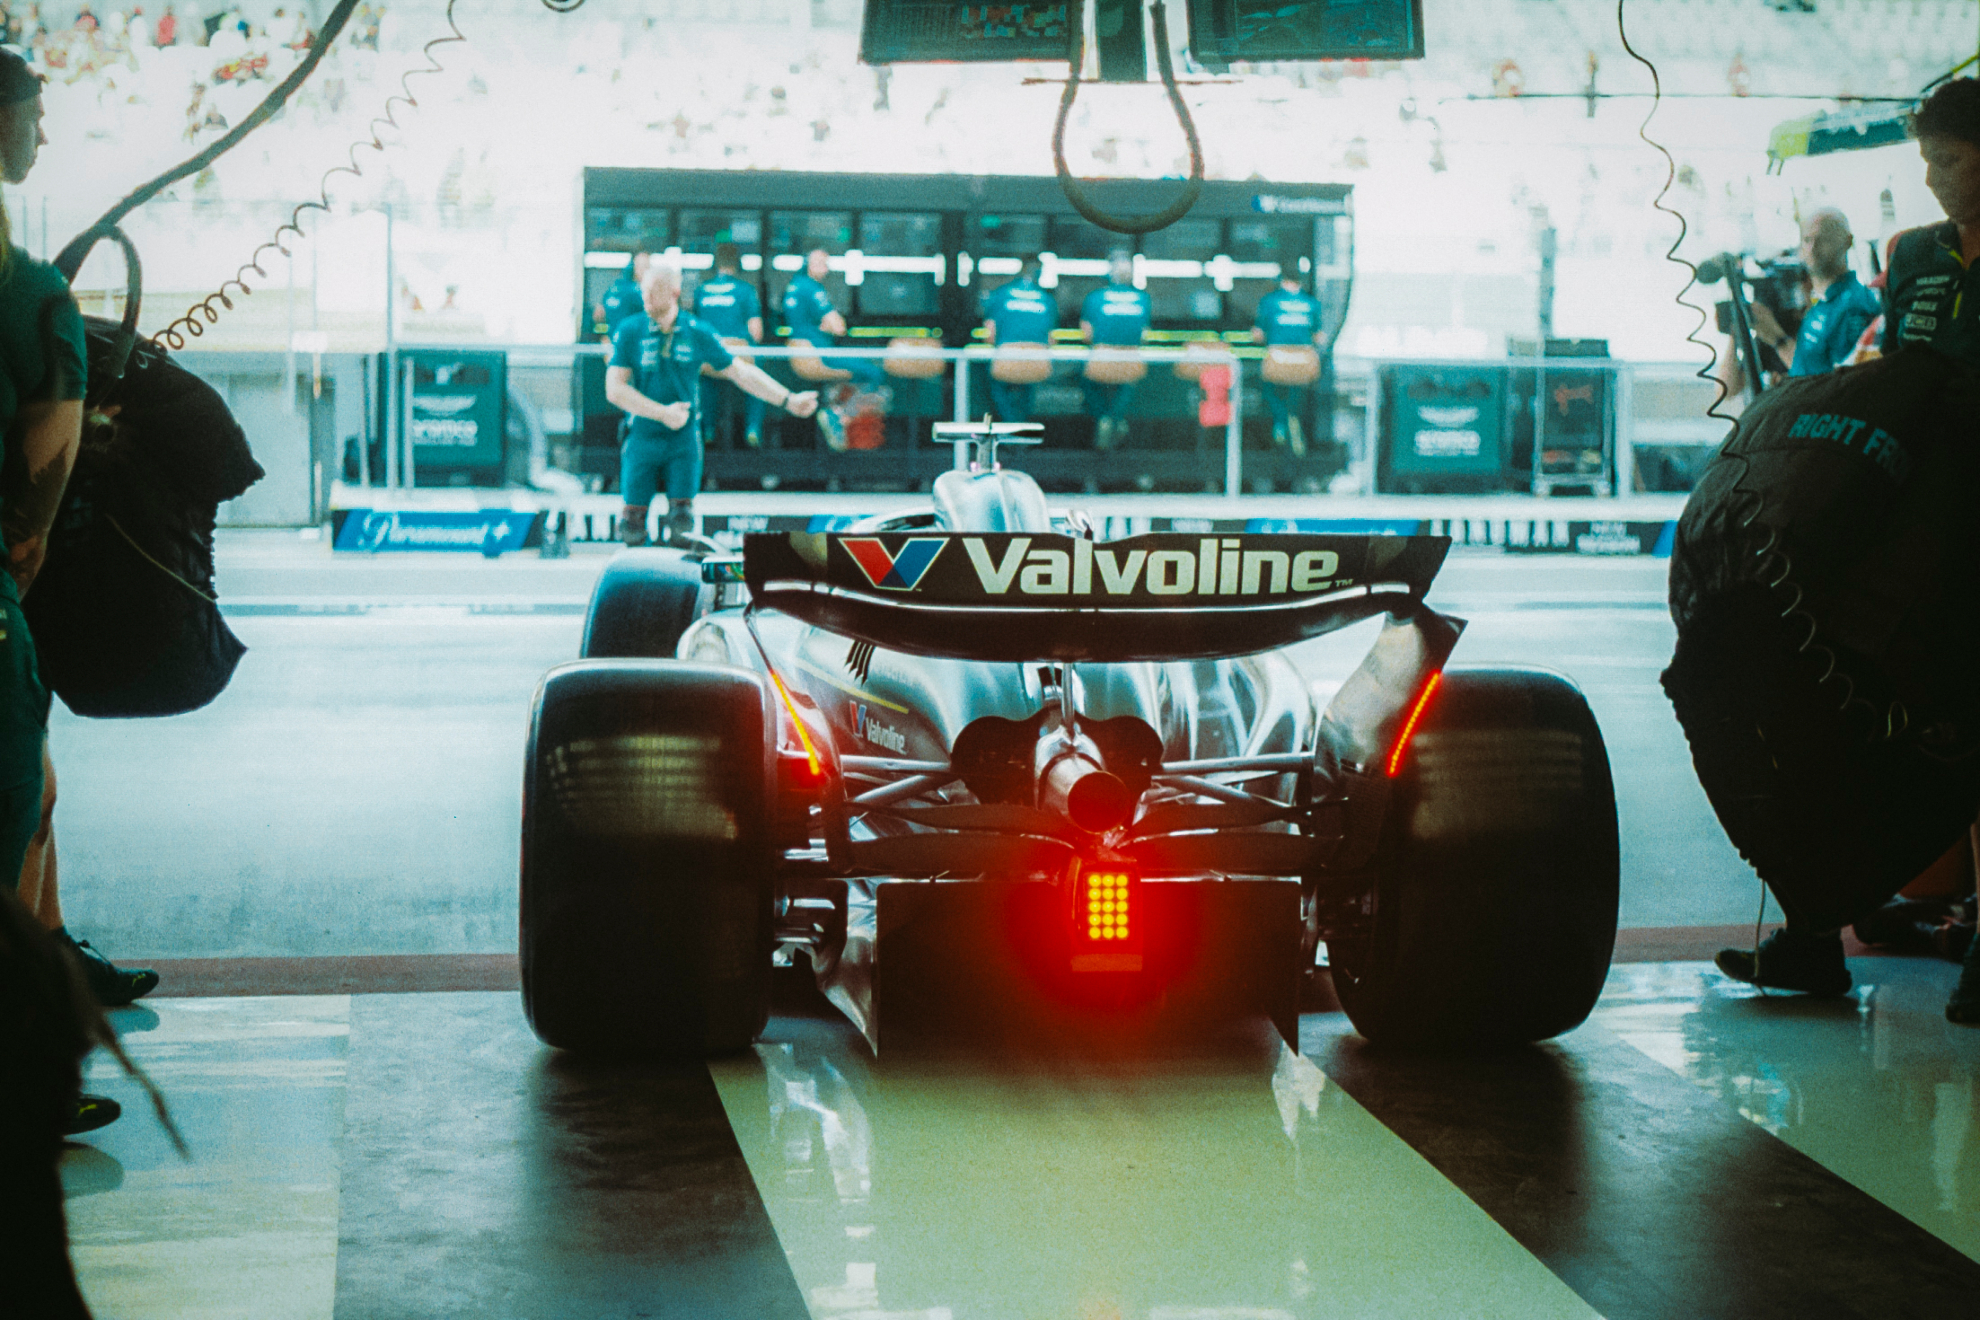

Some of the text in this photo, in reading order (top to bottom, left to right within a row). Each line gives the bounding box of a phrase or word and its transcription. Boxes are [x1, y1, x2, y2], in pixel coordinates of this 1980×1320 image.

[1788, 413, 1866, 445] RIGHT
[962, 538, 1339, 595] Valvoline
[865, 716, 907, 756] Valvoline
